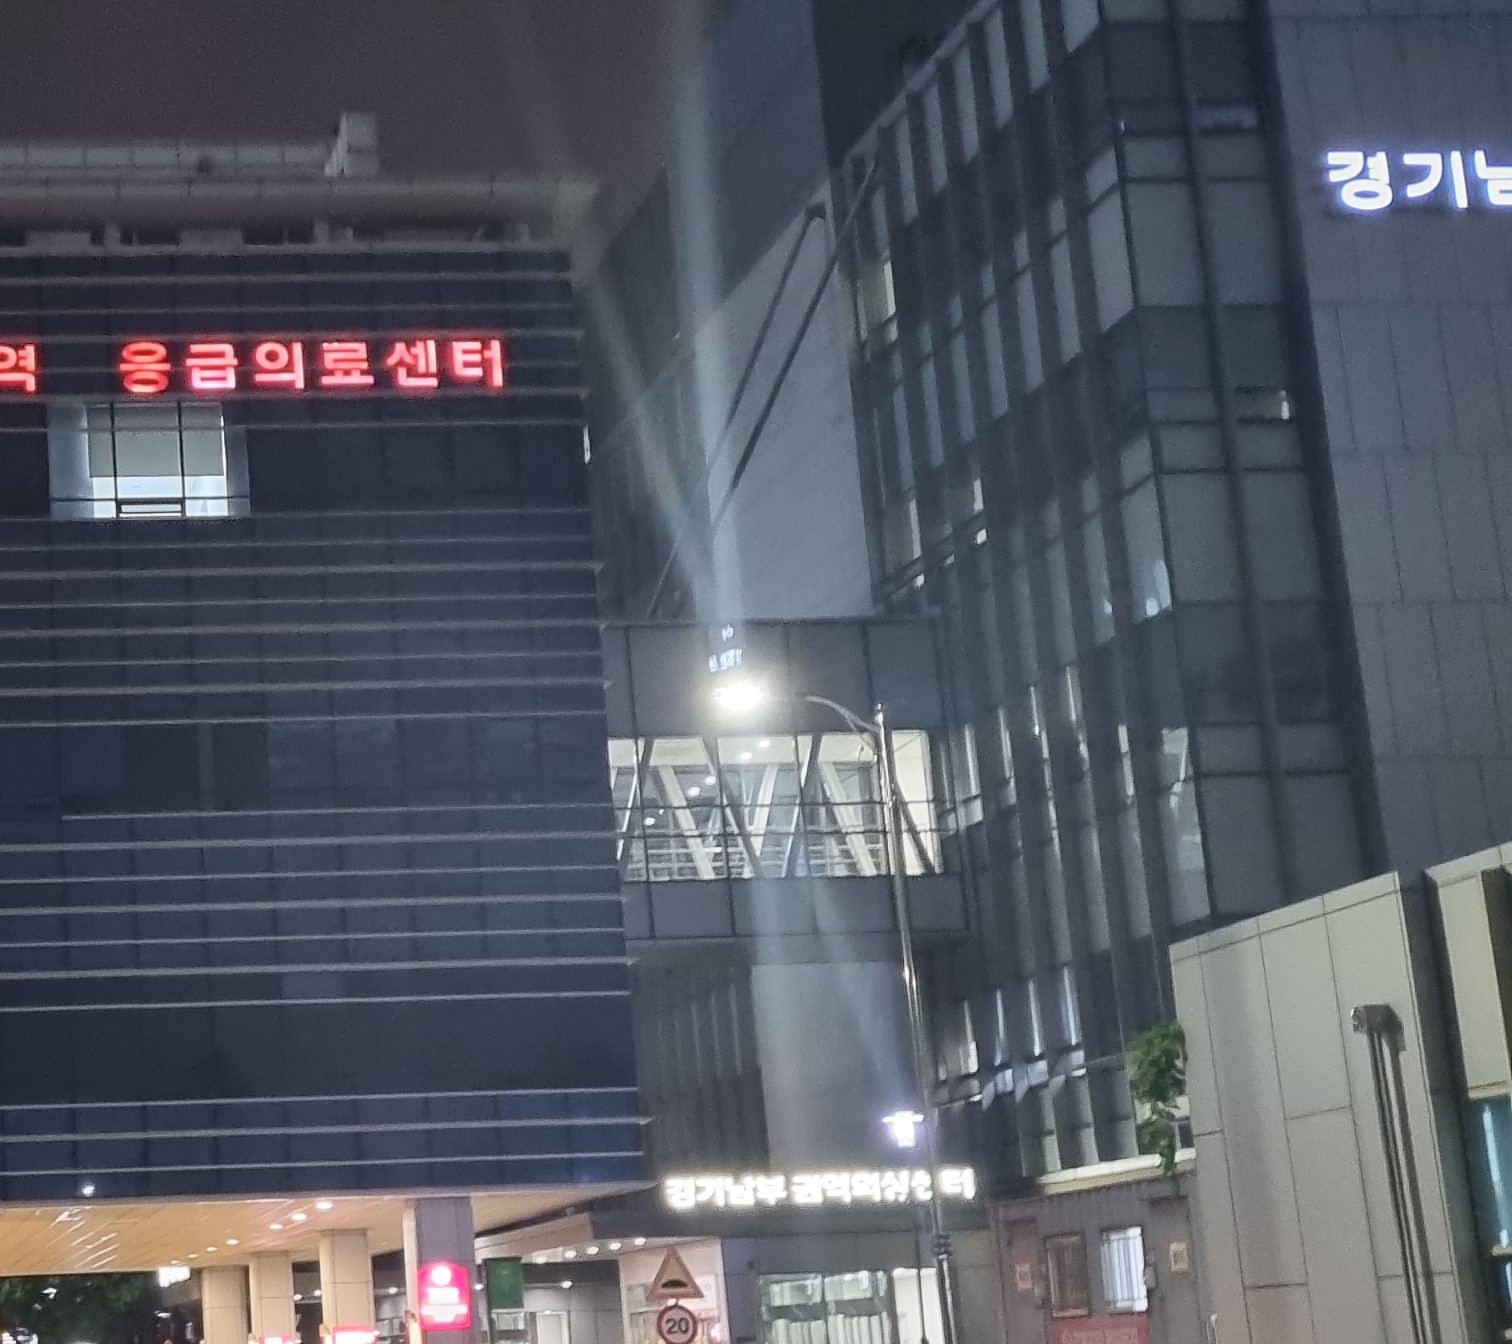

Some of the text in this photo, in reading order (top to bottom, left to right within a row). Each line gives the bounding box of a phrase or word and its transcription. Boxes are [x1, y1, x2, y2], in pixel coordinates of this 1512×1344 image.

[119, 338, 504, 393] 응급의료센터
[666, 1174, 787, 1208] 경기남부
[666, 1317, 689, 1334] 20
